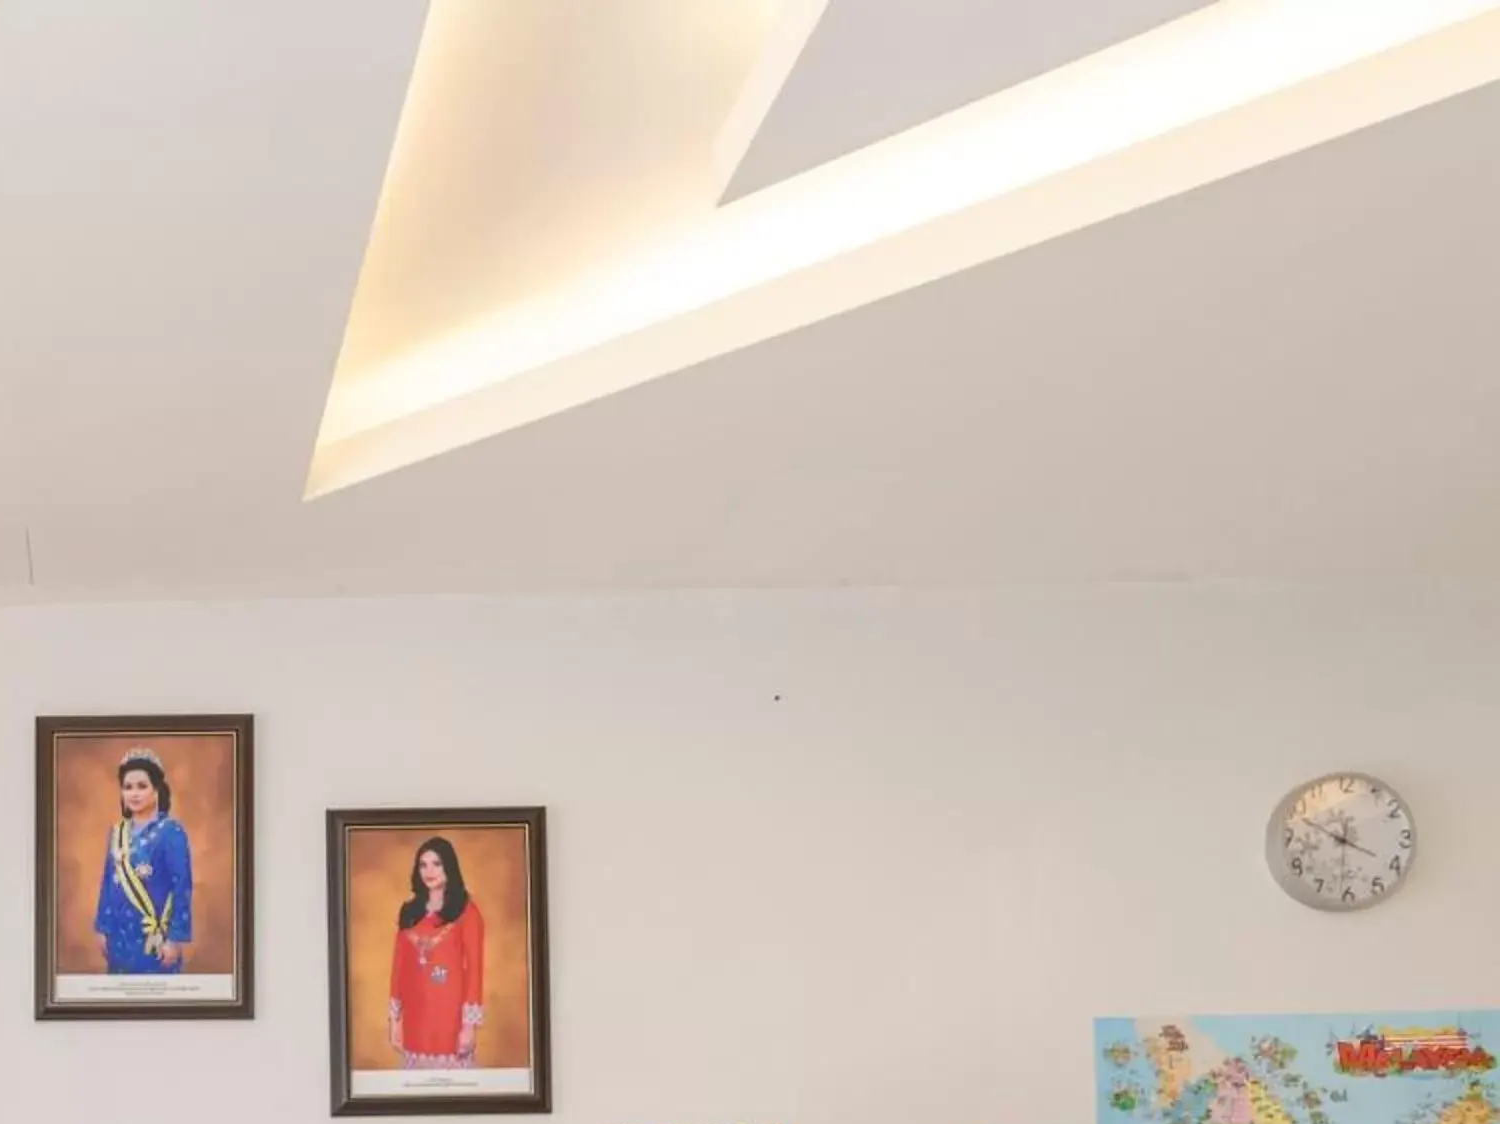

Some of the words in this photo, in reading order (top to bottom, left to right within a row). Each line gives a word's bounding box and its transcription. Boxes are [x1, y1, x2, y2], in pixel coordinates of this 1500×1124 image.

[1388, 800, 1401, 819] 2
[1399, 829, 1412, 849] 3
[1389, 855, 1402, 876] 4
[1314, 878, 1325, 893] 7
[1372, 877, 1384, 895] 5
